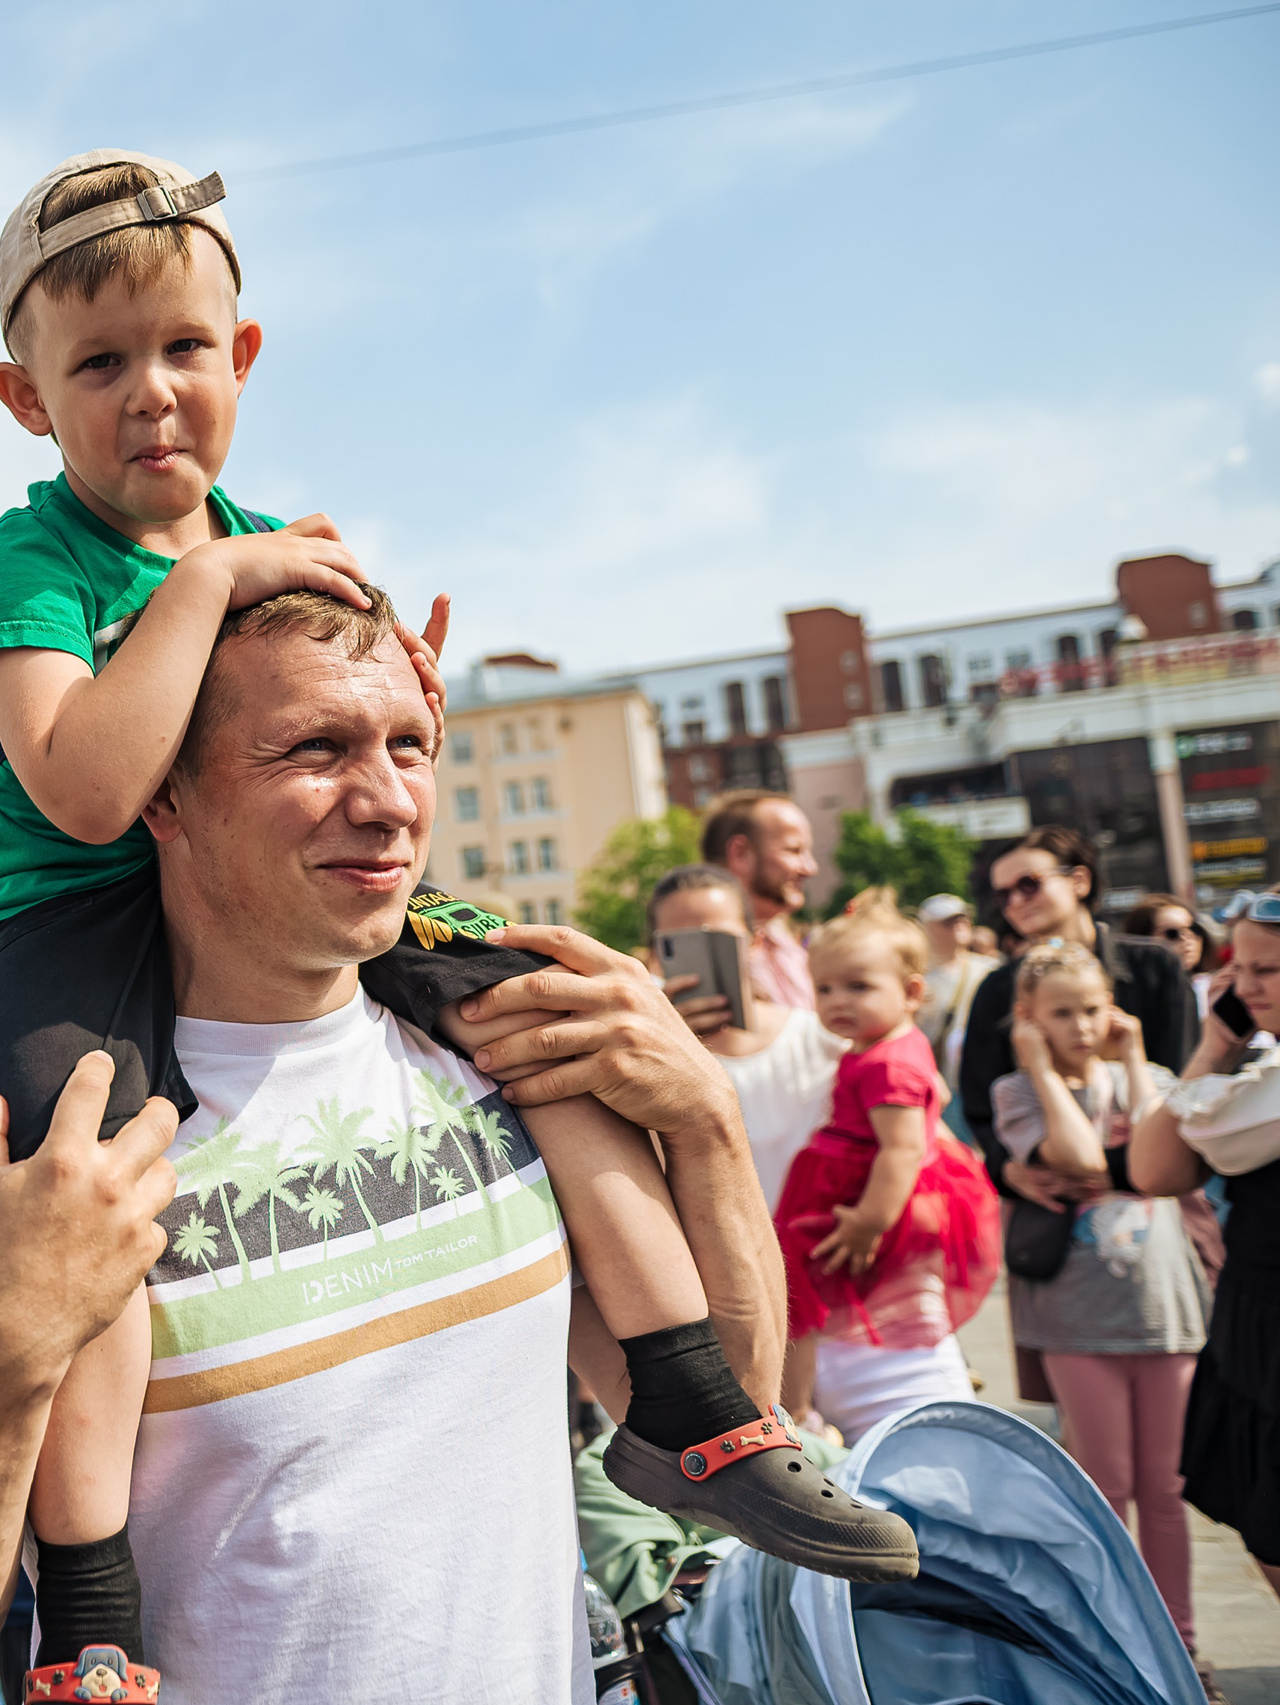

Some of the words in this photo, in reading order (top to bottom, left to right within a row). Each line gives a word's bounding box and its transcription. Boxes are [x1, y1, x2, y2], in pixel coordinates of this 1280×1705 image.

[302, 1257, 393, 1305] DENIM
[394, 1253, 424, 1270] TOM
[424, 1234, 479, 1260] TAILOR
